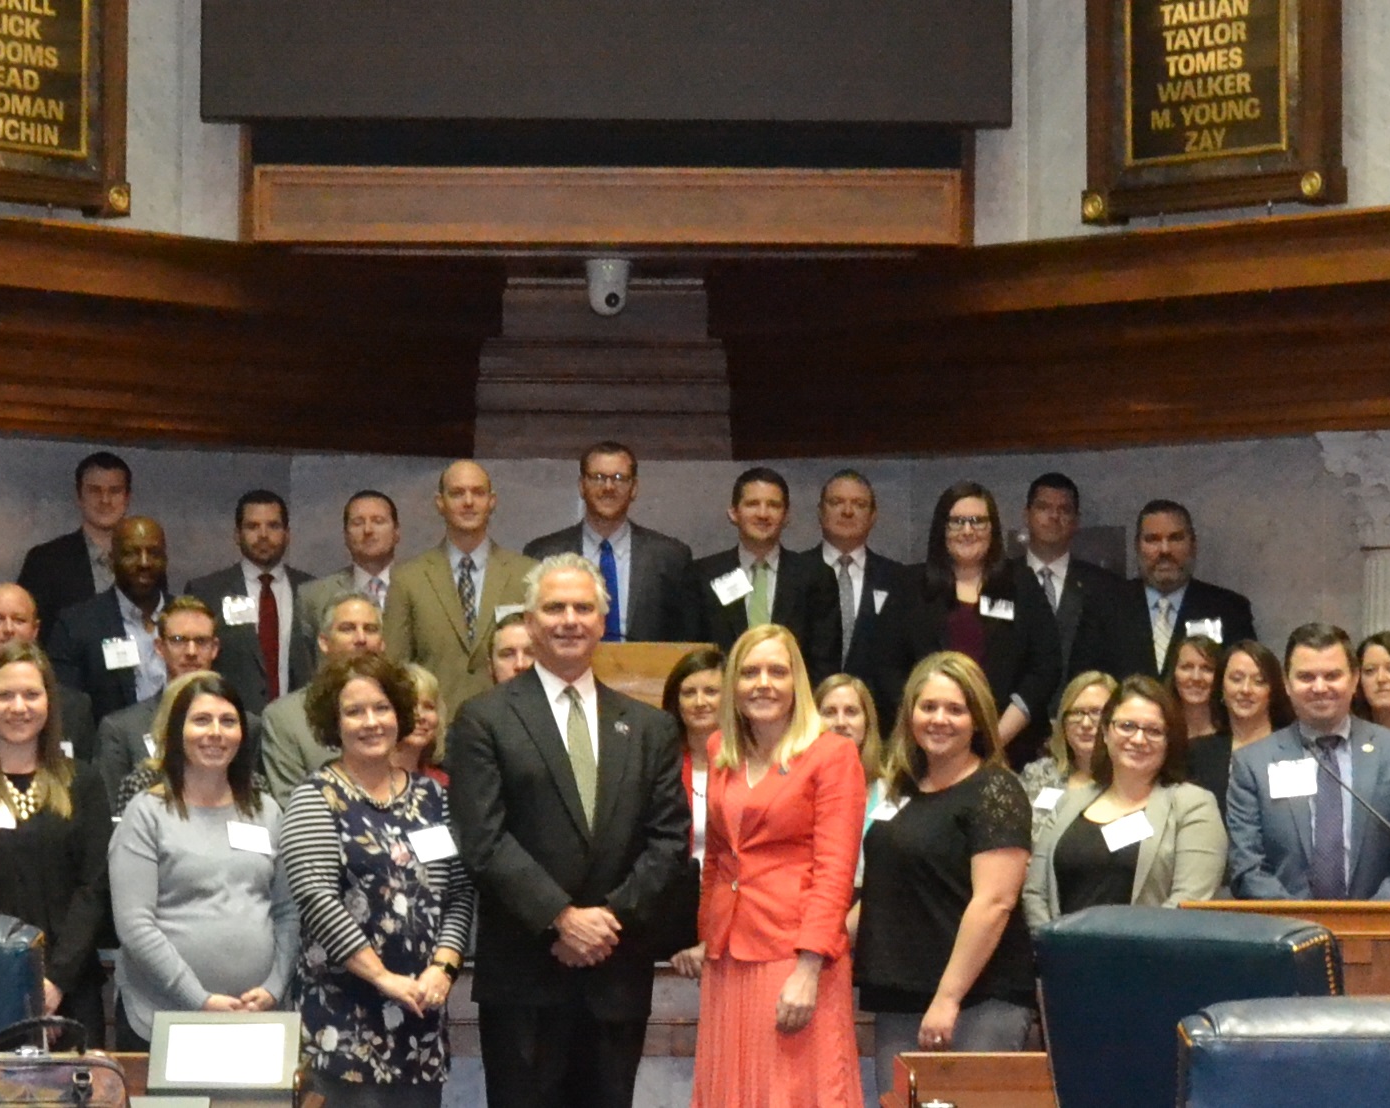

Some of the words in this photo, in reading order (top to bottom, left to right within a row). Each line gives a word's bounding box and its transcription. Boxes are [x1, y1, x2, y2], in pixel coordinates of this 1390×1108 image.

[1160, 0, 1249, 27] TALLIAN
[1163, 21, 1246, 51] TAYLOR
[1166, 47, 1243, 77] TOMES
[1157, 72, 1251, 103] WALKER
[1150, 109, 1175, 130] M.
[1180, 98, 1261, 127] YOUNG
[1185, 128, 1226, 152] ZAY
